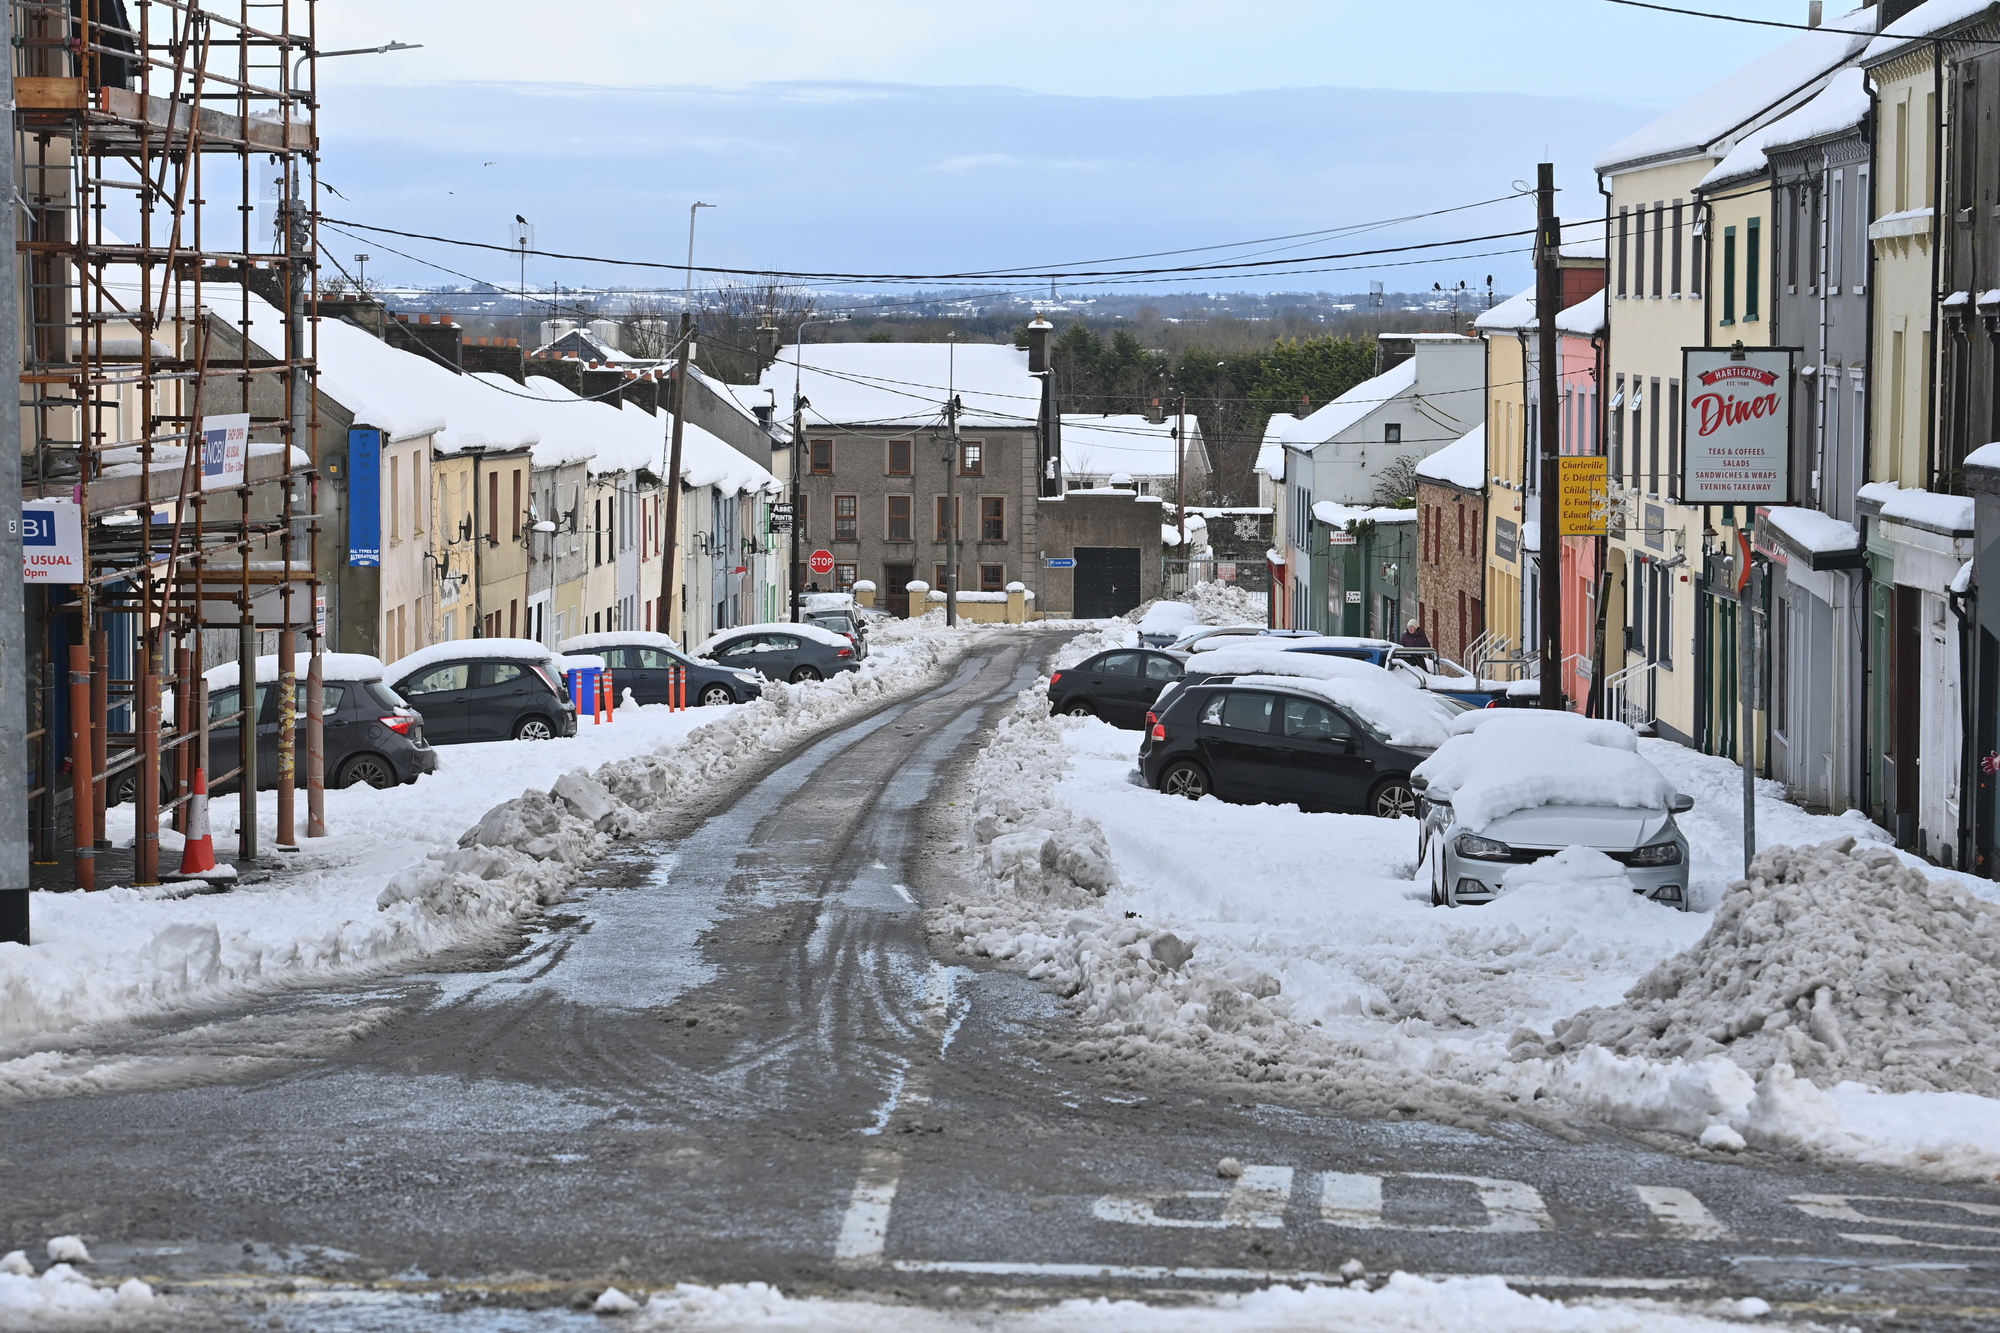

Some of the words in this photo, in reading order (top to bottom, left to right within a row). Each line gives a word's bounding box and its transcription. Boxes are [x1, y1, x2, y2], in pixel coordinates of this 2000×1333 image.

[1714, 367, 1763, 380] HARTIGANS
[1691, 392, 1783, 437] Diner
[206, 440, 225, 465] NCBI
[1561, 461, 1604, 469] Charleville
[1563, 486, 1601, 494] Childce
[1700, 483, 1732, 491] EVENING
[1733, 483, 1772, 491] TAKEAWAY
[1564, 498, 1571, 506] &
[10, 522, 16, 532] 5
[23, 519, 48, 538] BI
[31, 555, 72, 566] USUAL
[350, 554, 380, 562] ALTERATIONS
[811, 557, 833, 567] STOP
